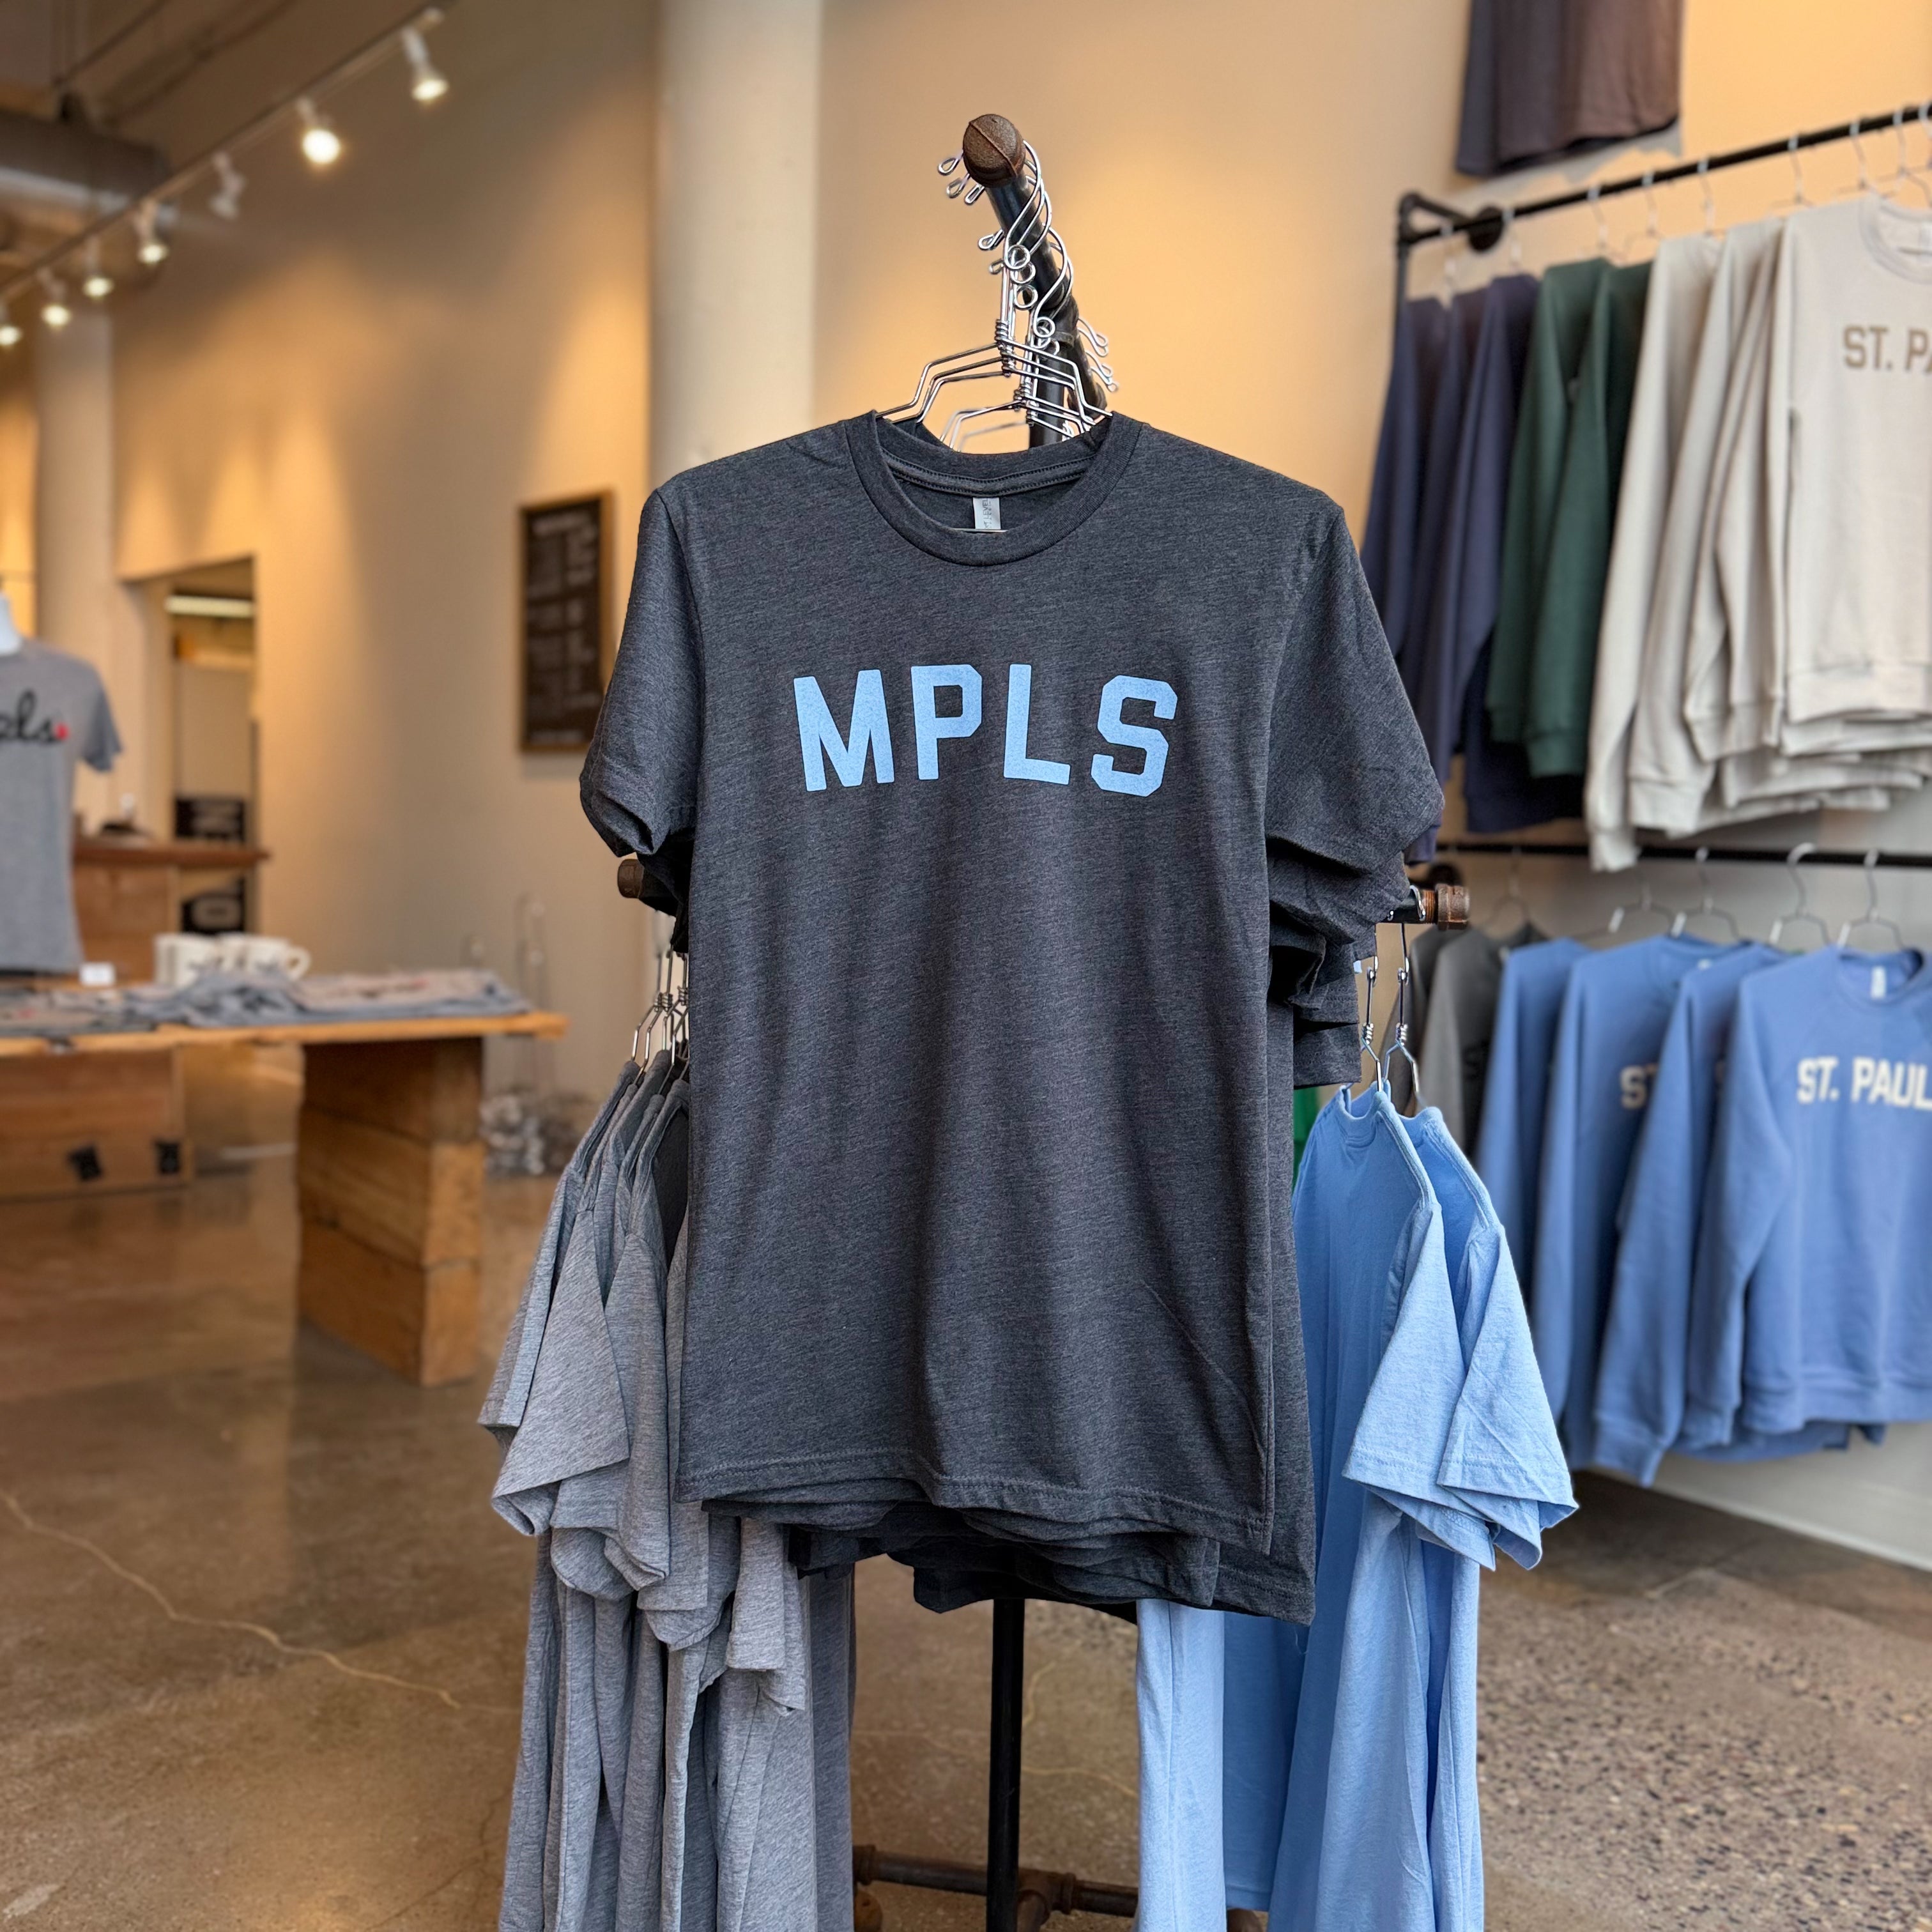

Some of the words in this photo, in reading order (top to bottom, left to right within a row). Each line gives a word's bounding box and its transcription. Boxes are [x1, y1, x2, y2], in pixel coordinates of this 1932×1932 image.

[1843, 325, 1893, 371] ST.
[793, 664, 1177, 797] MPLS
[1620, 1063, 1659, 1109] S
[1797, 1055, 1840, 1105] ST.
[1851, 1055, 1932, 1112] PAUL
